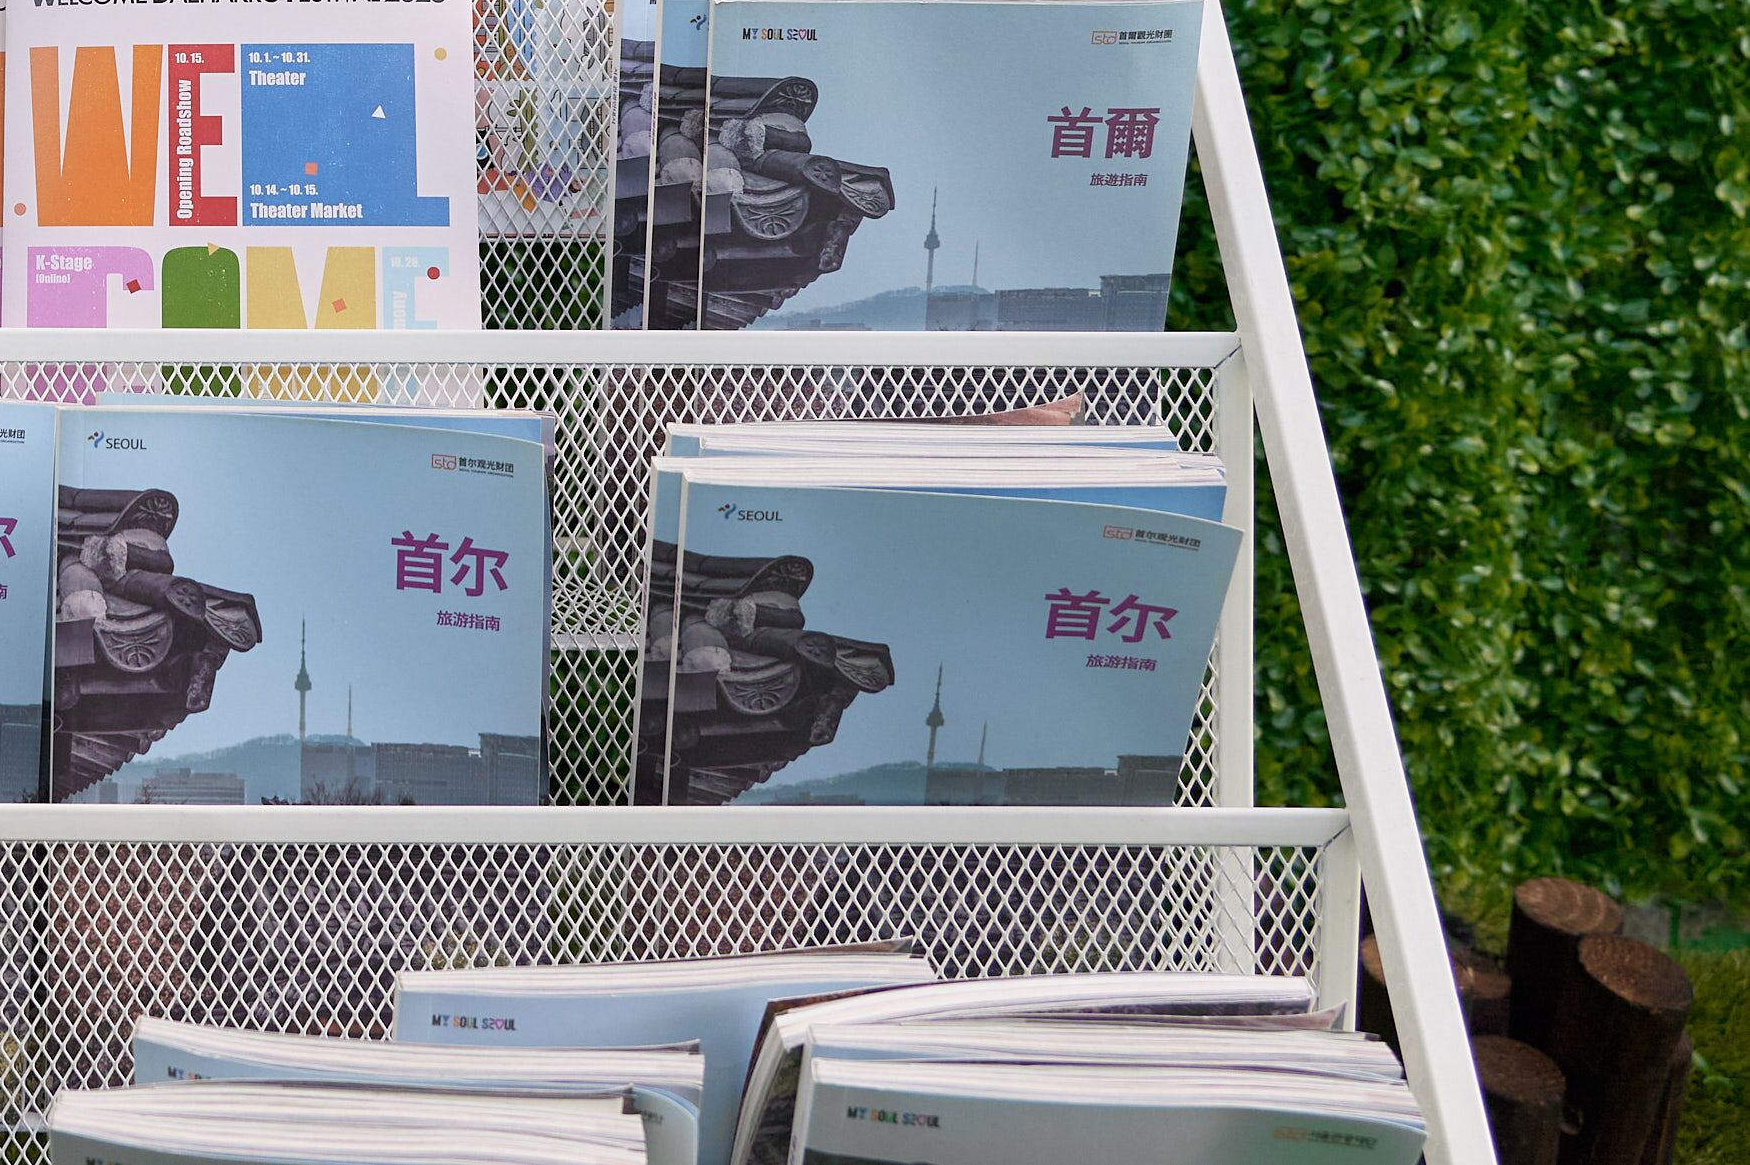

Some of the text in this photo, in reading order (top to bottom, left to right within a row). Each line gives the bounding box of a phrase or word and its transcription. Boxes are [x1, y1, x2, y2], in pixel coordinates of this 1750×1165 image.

[248, 70, 307, 86] Theater
[1046, 105, 1161, 160] 首爾
[176, 79, 194, 220] Opening Roadshow
[1089, 172, 1148, 188] 旅遊指南
[250, 202, 363, 219] Theater Market
[35, 254, 93, 272] K-Stage
[106, 437, 147, 451] SEOUL
[458, 457, 514, 473] 首尔观光财团
[737, 508, 783, 523] SEOUL
[391, 529, 510, 599] 首尔
[436, 609, 501, 633] 旅游指南
[1044, 586, 1179, 645] 首尔
[1085, 653, 1157, 673] 旅游指南
